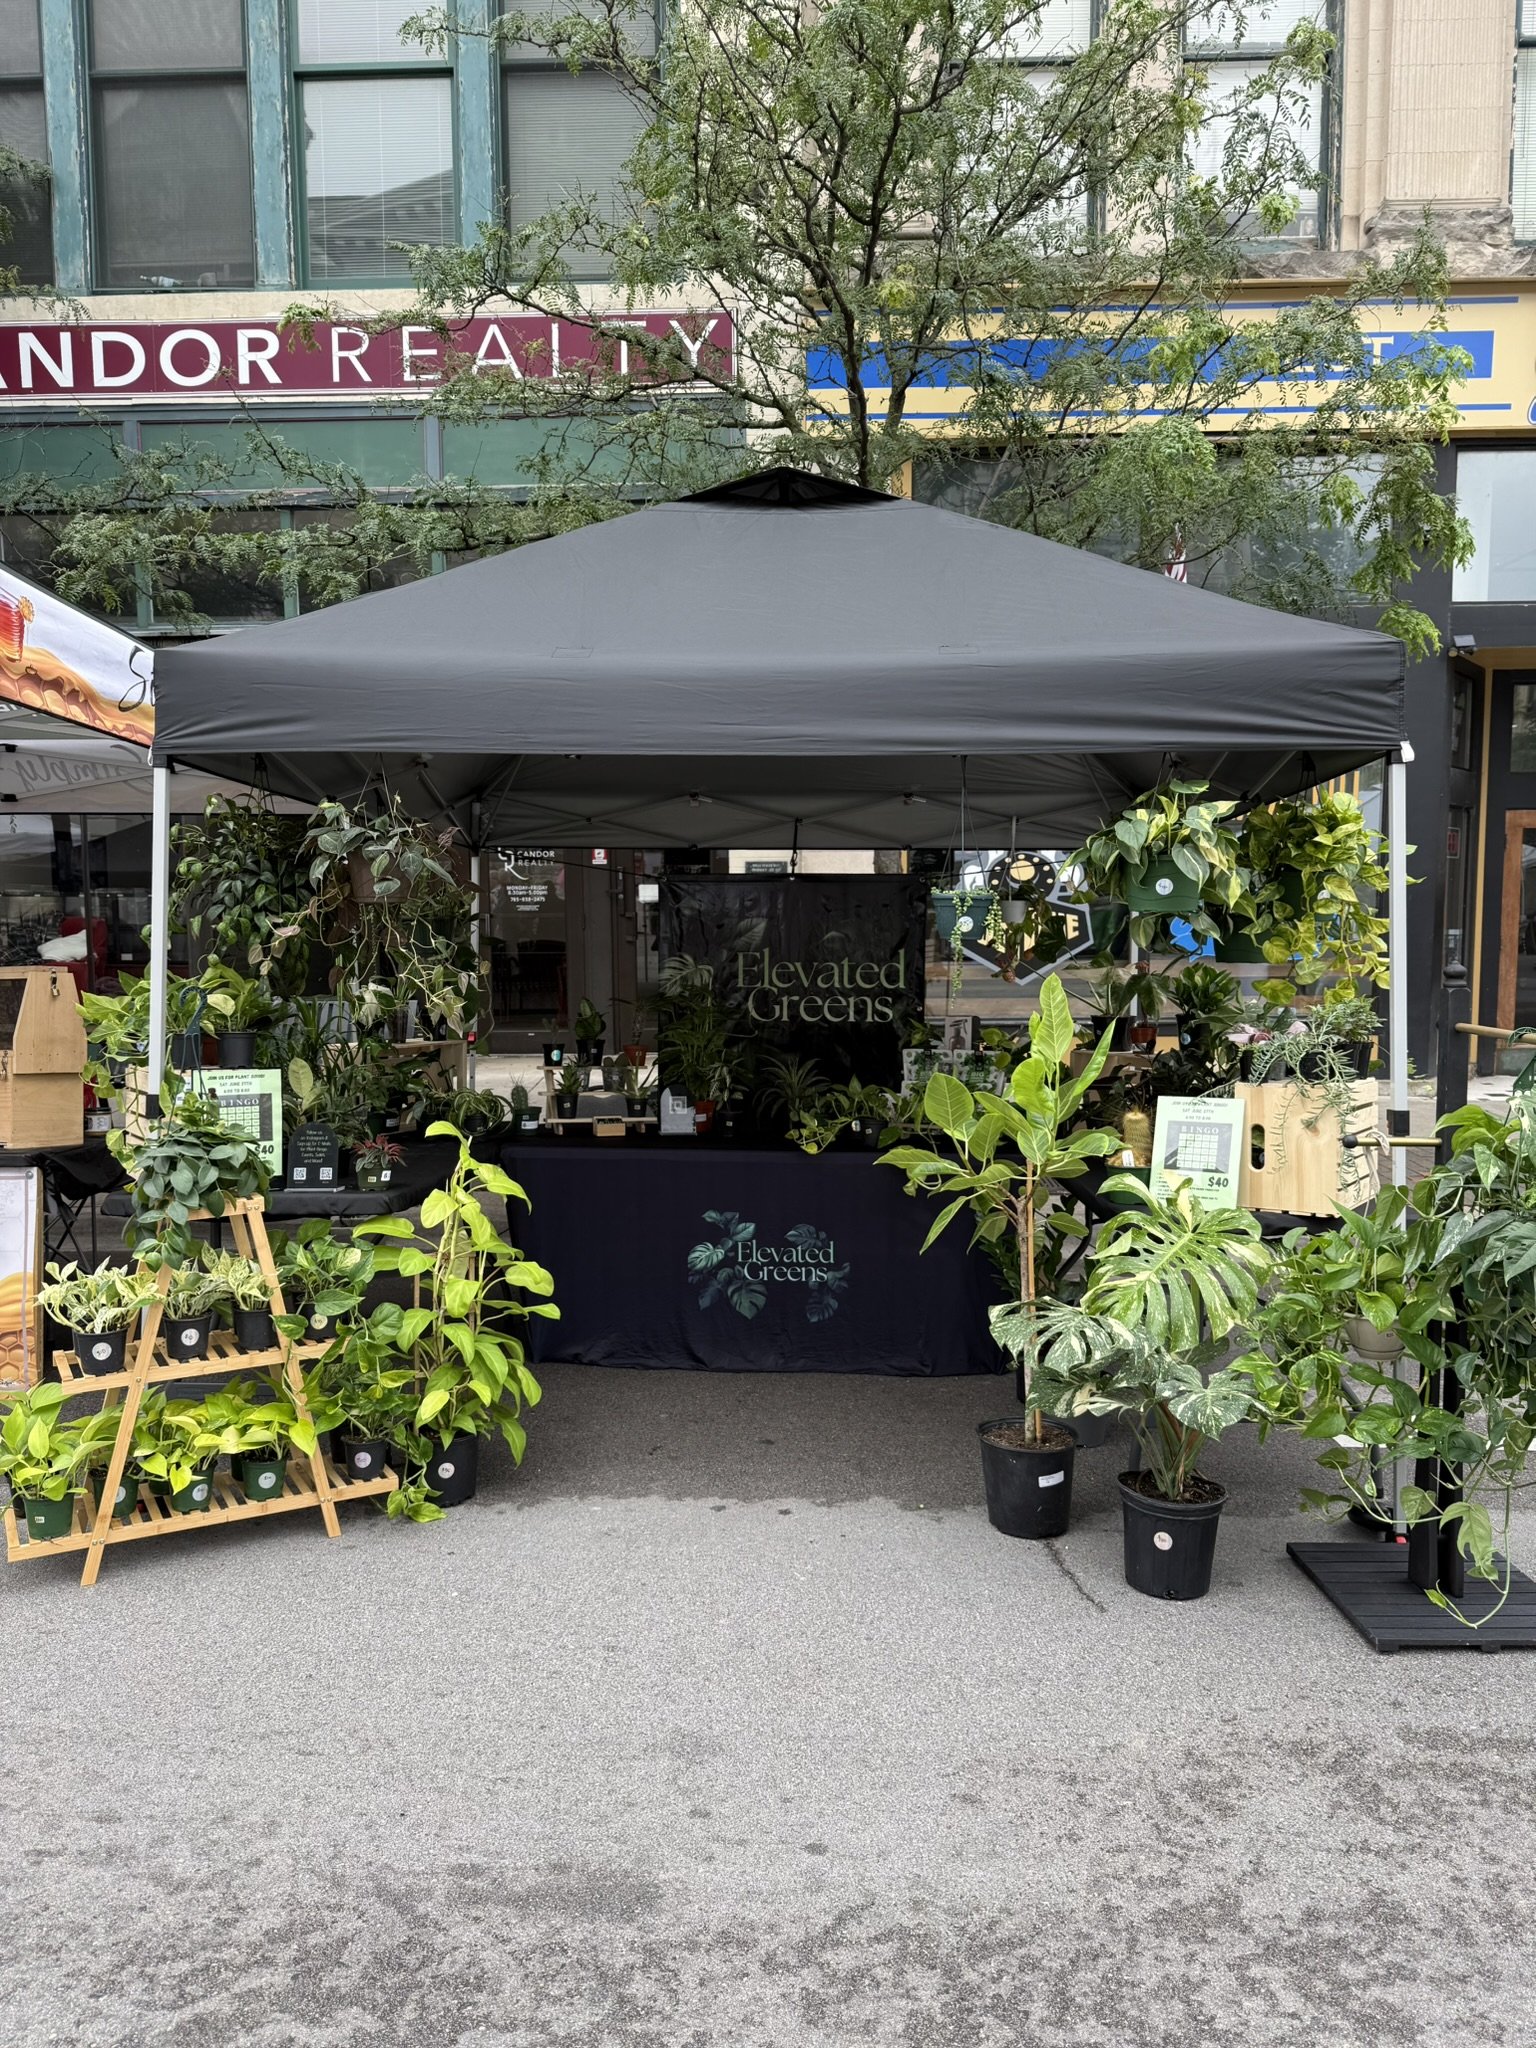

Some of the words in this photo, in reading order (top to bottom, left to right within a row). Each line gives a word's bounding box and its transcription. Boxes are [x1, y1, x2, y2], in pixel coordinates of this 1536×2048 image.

[0, 329, 282, 388] NDOR
[517, 850, 555, 858] CANDOR
[737, 948, 906, 989] Elevated
[747, 986, 894, 1023] Greens
[220, 1098, 259, 1107] BINGO
[1181, 1125, 1219, 1135] BINGO
[254, 1144, 274, 1156] $40
[1207, 1175, 1229, 1188] $40
[737, 1239, 835, 1264] Elevated
[743, 1261, 828, 1283] Greens
